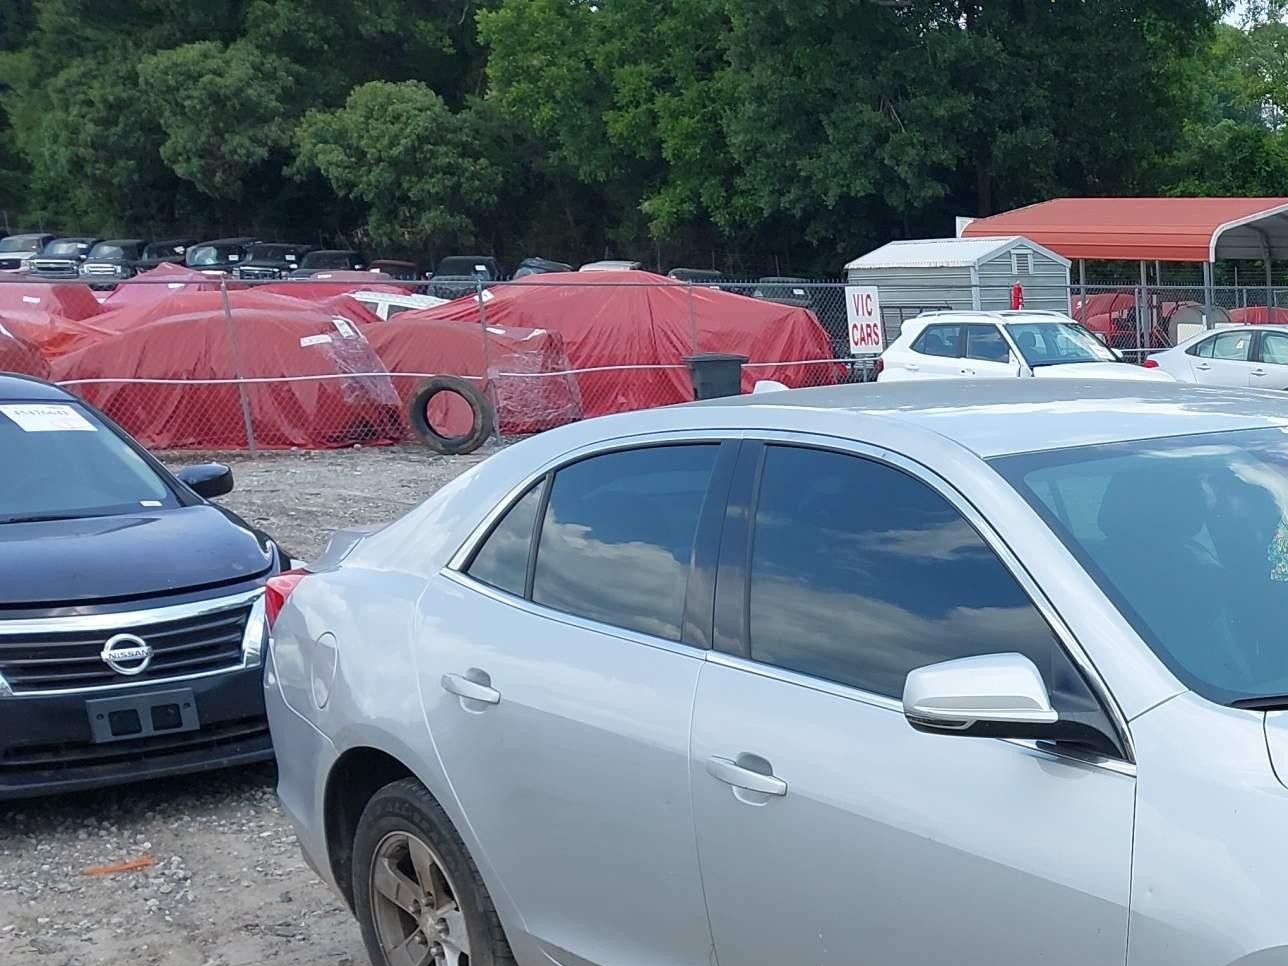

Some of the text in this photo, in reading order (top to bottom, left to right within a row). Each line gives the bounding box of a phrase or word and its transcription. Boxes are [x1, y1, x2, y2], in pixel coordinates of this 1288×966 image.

[852, 294, 873, 317] VIC
[851, 323, 880, 346] CARS
[108, 649, 149, 659] NISSAN
